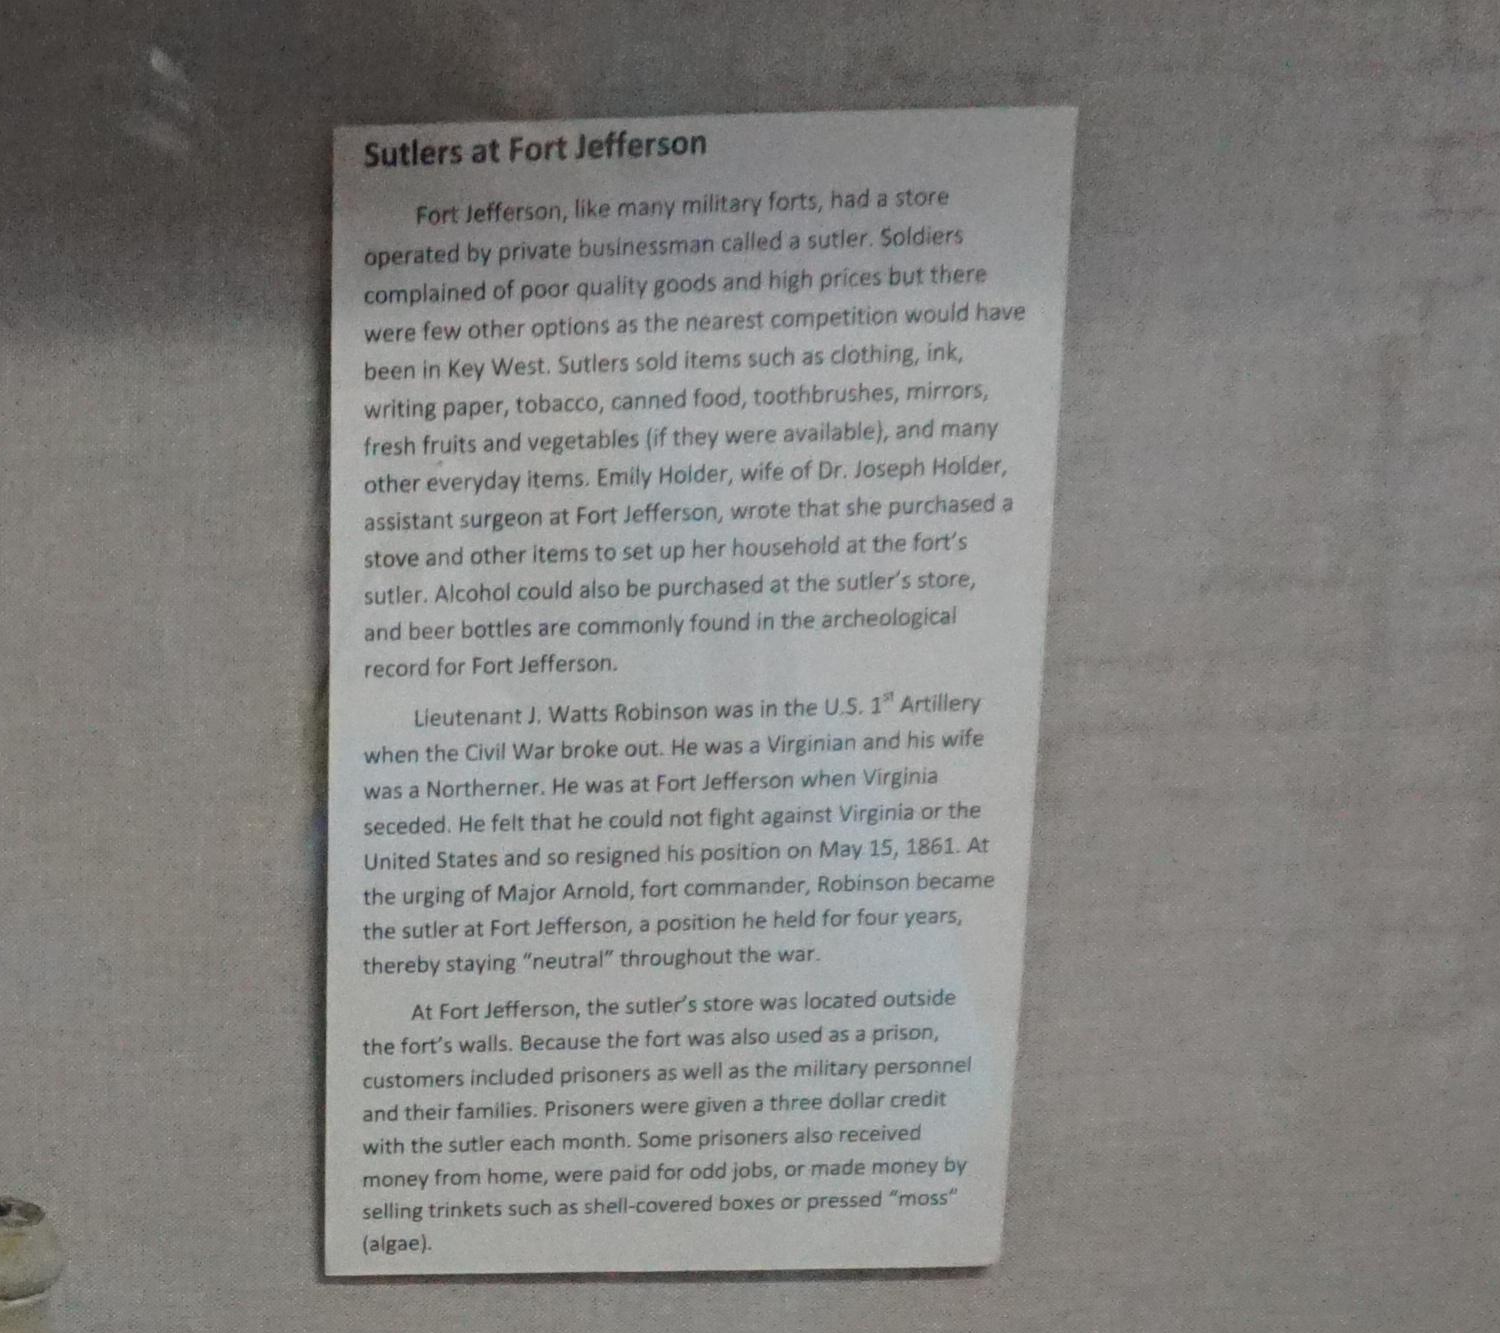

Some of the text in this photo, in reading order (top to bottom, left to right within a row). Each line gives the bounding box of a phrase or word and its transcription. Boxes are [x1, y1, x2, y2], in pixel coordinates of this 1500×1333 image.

[362, 128, 707, 168] Sutlers at Fort Jefferson
[363, 651, 617, 678] record for Fort Jefferson.
[362, 834, 989, 872] United States and so resigned his position on May 15, 1861. At
[361, 951, 441, 978] thereby
[444, 951, 517, 977] staying
[619, 944, 732, 972] throughout
[737, 942, 772, 965] the
[776, 947, 819, 964] war.
[361, 1230, 431, 1258] (algae).
